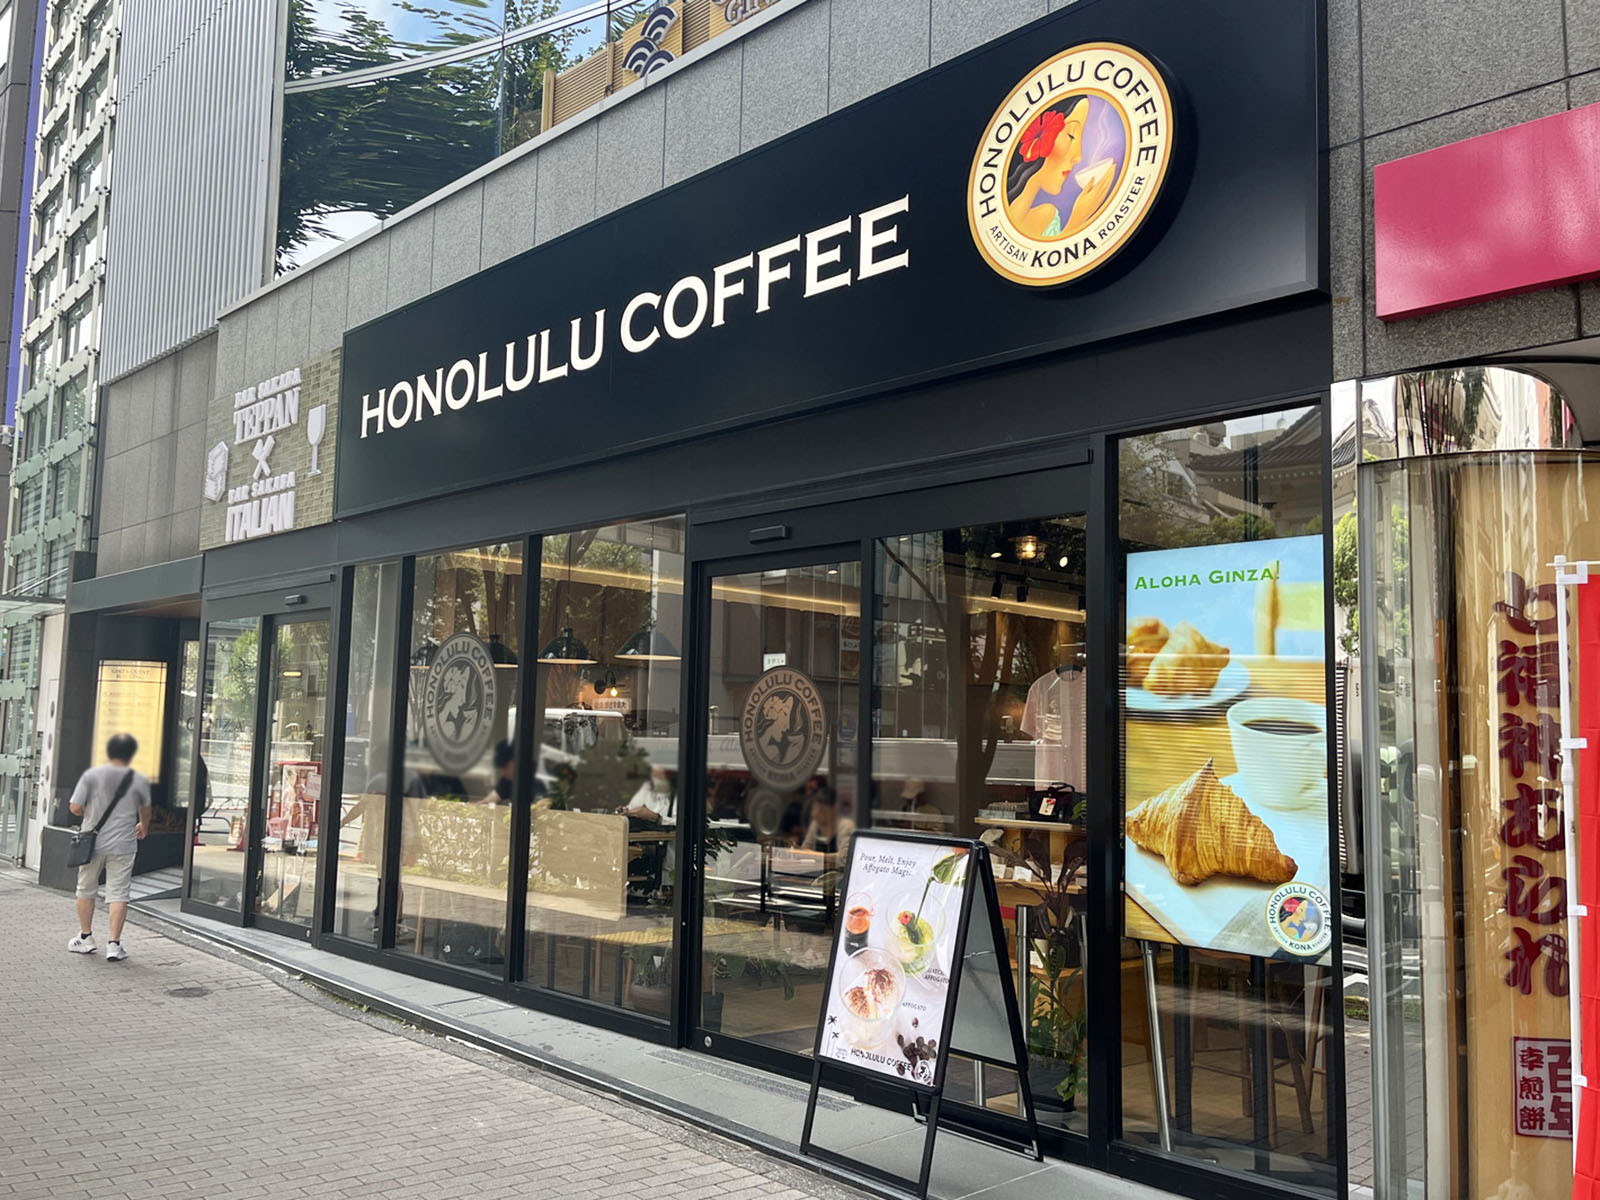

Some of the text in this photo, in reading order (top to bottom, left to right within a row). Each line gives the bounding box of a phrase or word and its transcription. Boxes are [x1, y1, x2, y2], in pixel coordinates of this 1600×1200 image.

[980, 60, 1159, 218] HONOLULU COFFEE
[989, 175, 1146, 268] ARTISAN KONA ROASTER
[360, 193, 909, 439] HONOLULU COFFEE
[233, 387, 301, 445] TEPPAN
[225, 490, 295, 542] ITALIAN
[426, 640, 494, 721] HONOLULU COFFEE
[744, 673, 823, 745] HONOLULU COFFEE
[1268, 886, 1331, 931] HONOLULU COFFEE
[1289, 942, 1312, 951] KONA
[850, 1048, 886, 1064] HONOLULU
